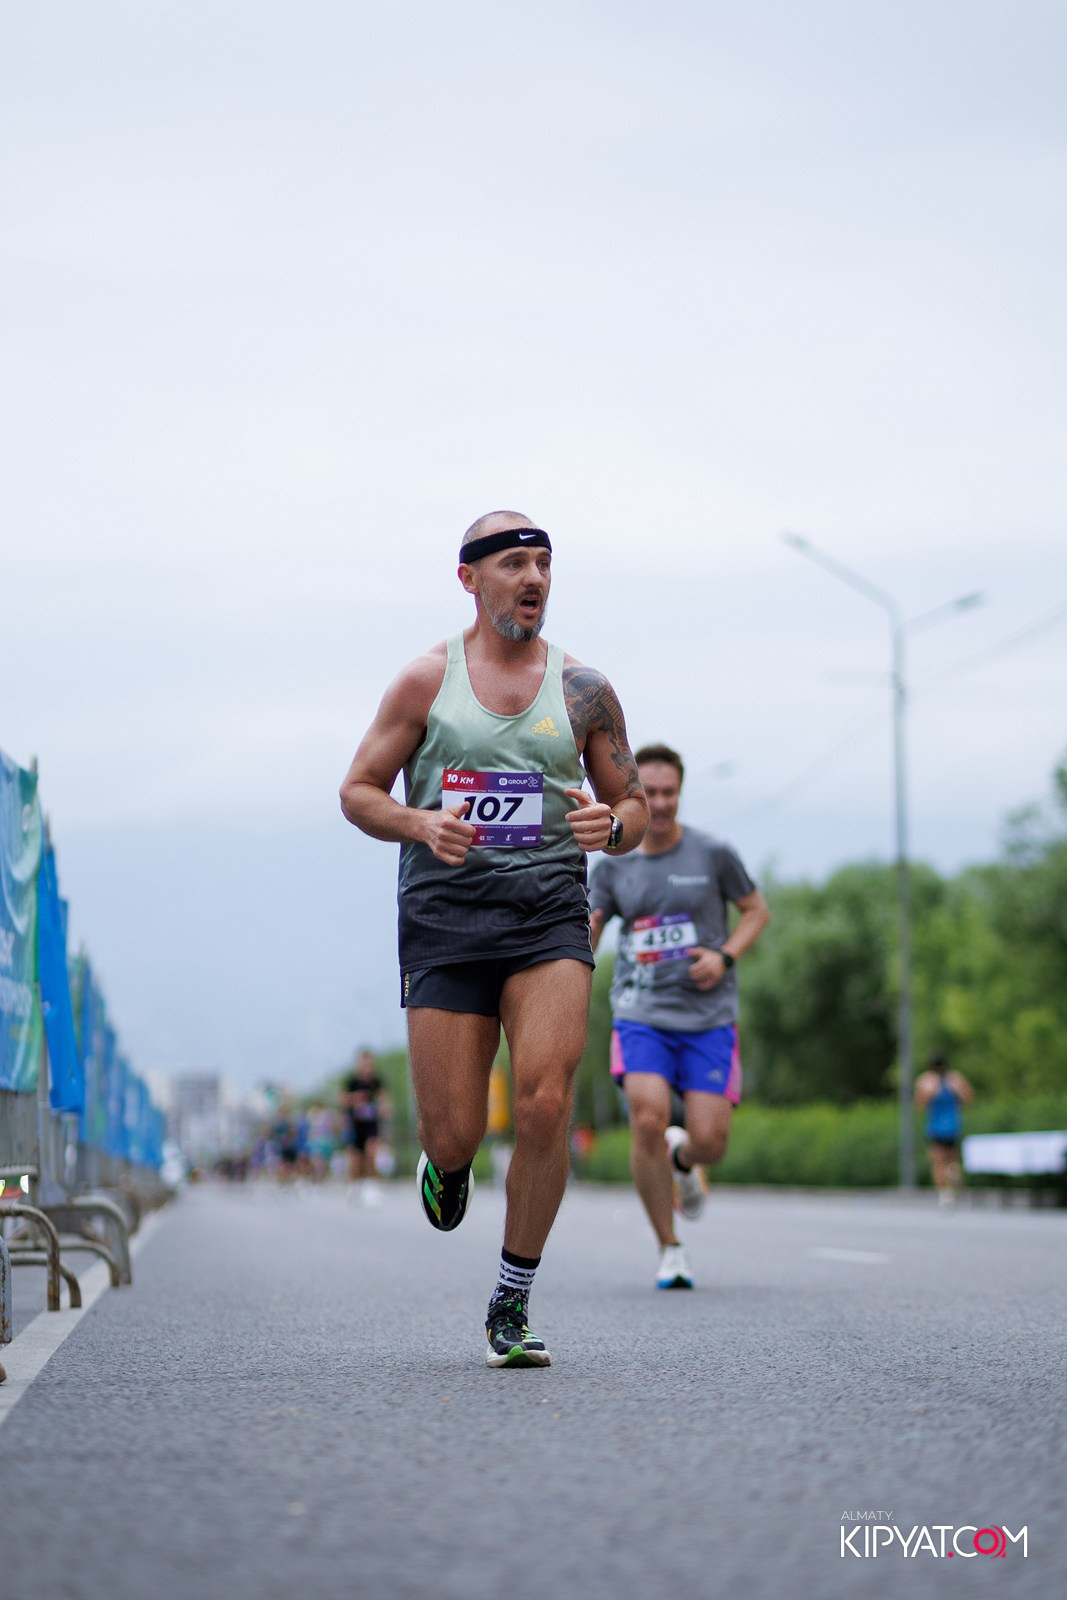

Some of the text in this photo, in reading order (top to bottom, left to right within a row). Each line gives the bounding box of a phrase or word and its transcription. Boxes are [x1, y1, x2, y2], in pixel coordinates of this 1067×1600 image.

[531, 726, 560, 737] adidas
[446, 774, 458, 783] 10
[463, 796, 524, 822] 107
